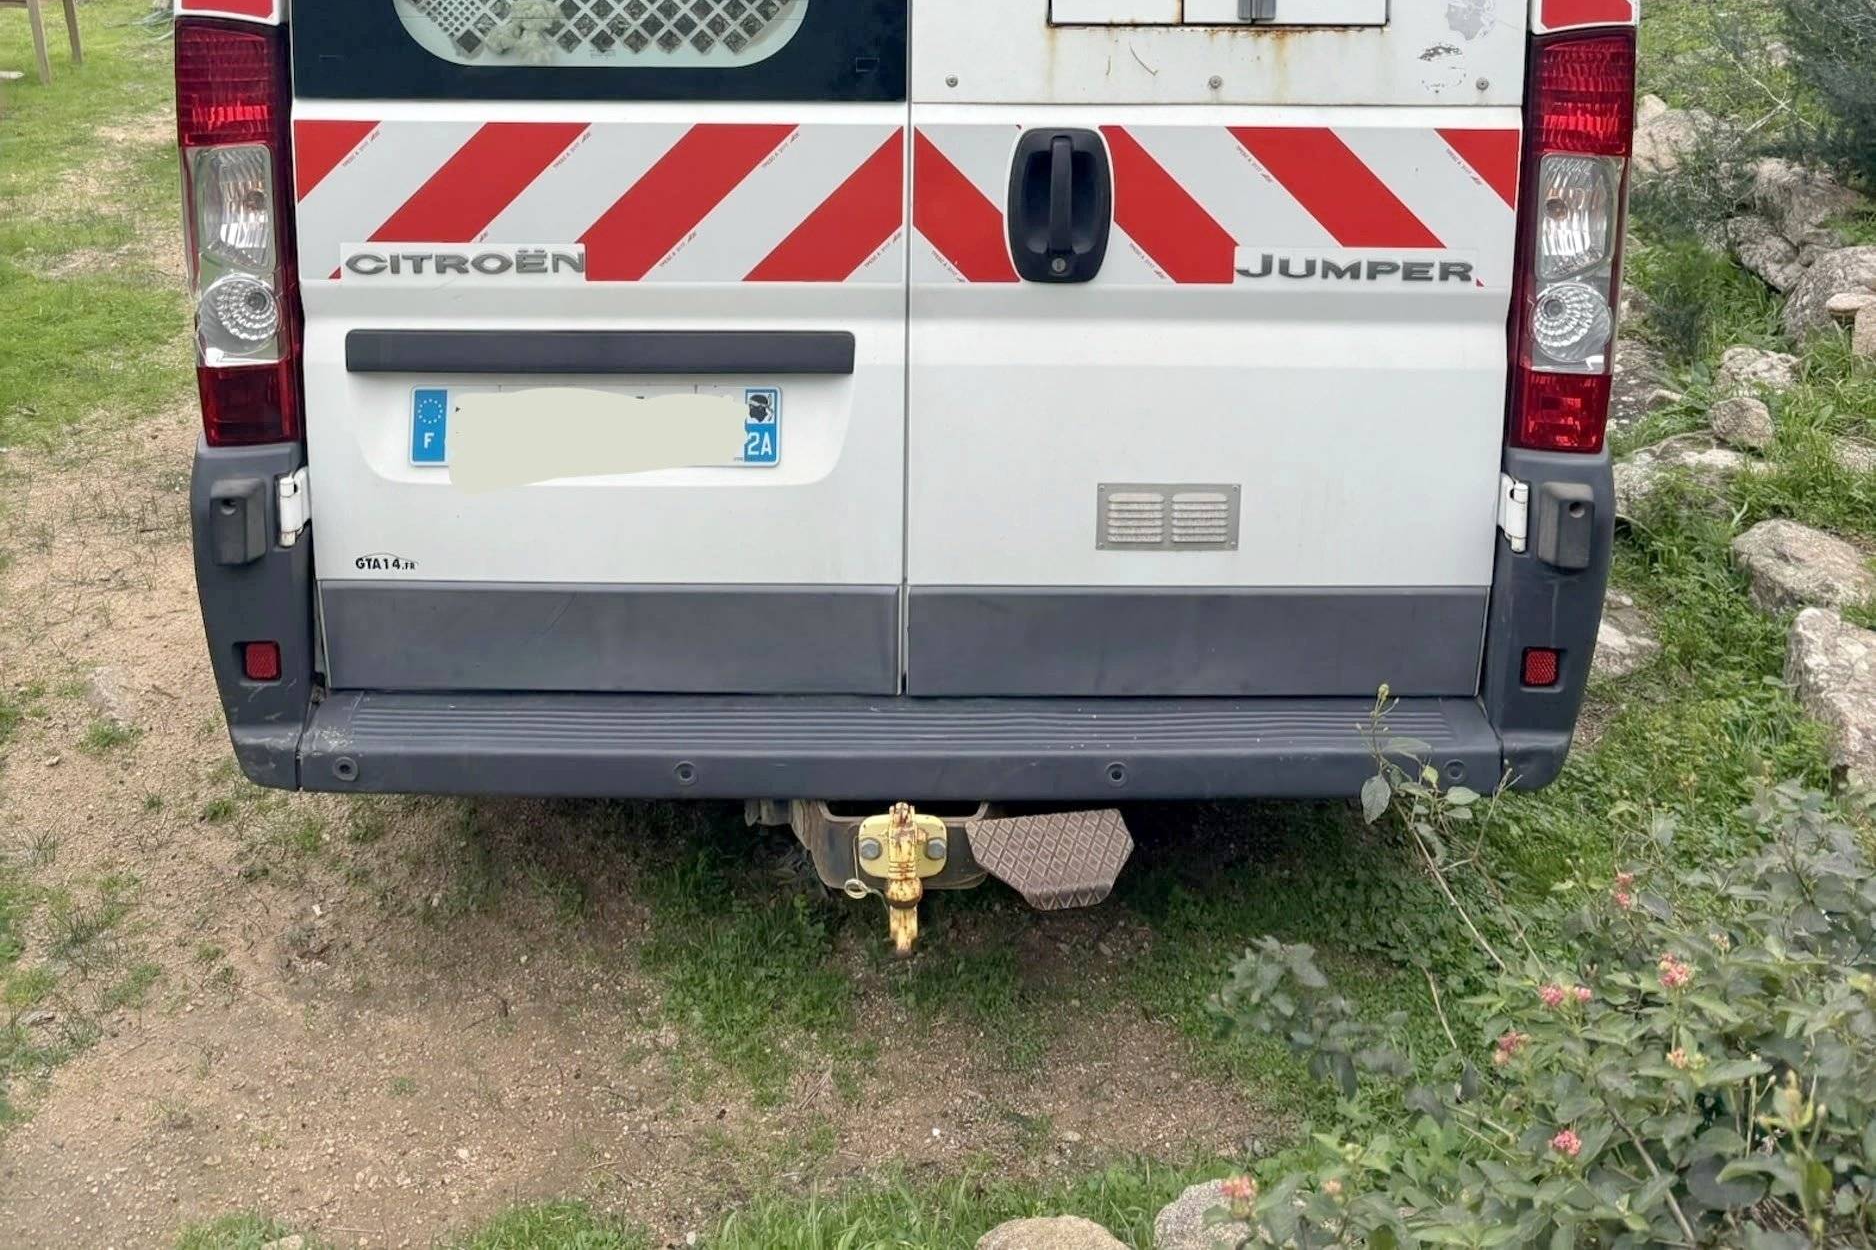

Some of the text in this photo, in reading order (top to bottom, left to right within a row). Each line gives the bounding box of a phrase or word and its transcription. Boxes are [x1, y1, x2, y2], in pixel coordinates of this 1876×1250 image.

[345, 248, 585, 275] CITROËN
[1235, 253, 1474, 282] JUMPER
[423, 432, 435, 449] F
[747, 431, 773, 456] 2A
